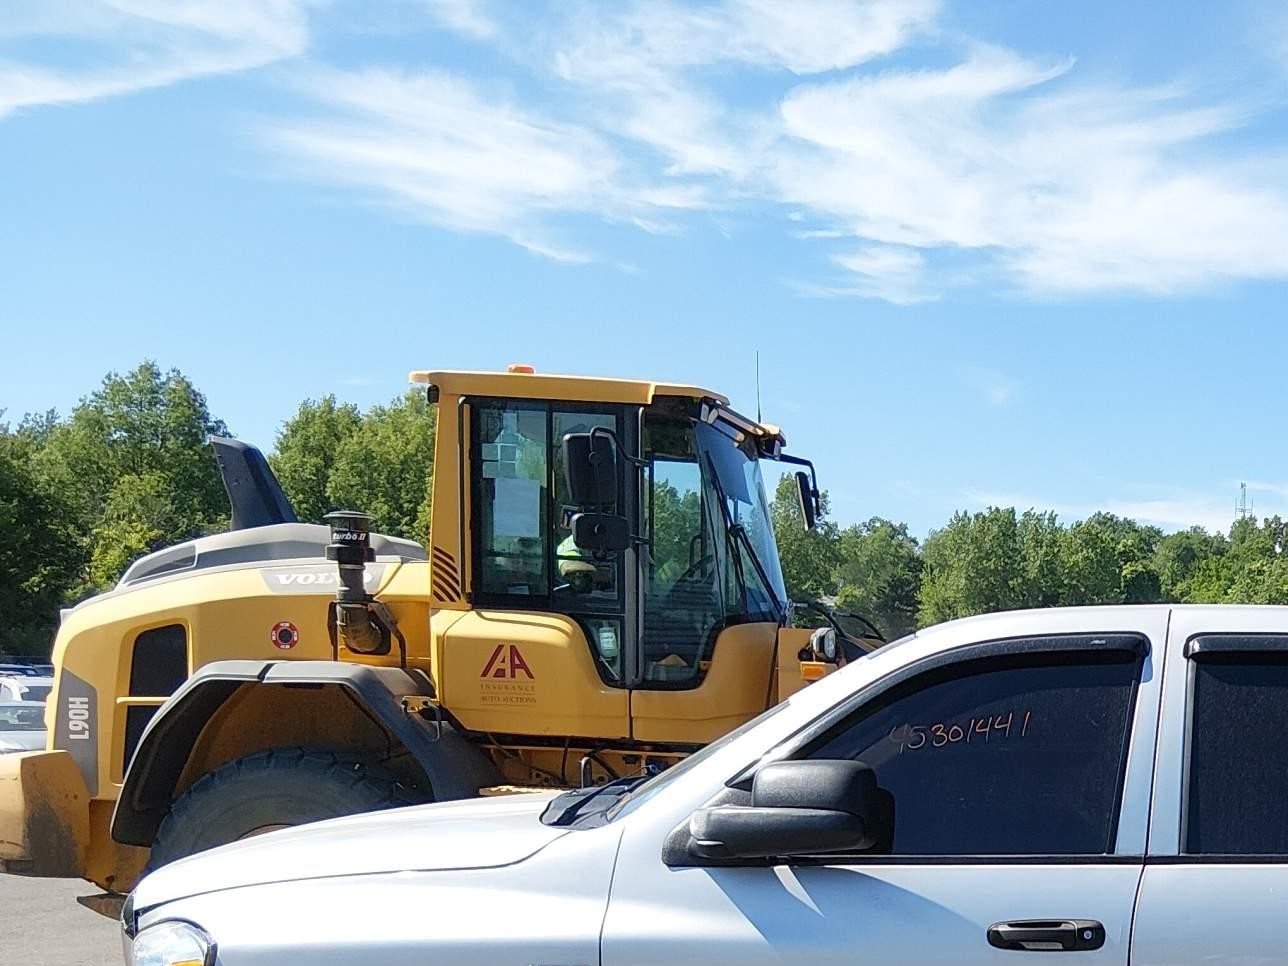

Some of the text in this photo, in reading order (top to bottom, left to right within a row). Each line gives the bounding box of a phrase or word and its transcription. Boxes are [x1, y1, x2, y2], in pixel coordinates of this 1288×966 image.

[332, 531, 358, 541] turbo
[480, 683, 536, 693] INSURANCE
[481, 695, 537, 704] AUTO AUCTIONS
[68, 697, 90, 740] L90H
[889, 711, 1032, 754] 45301441
